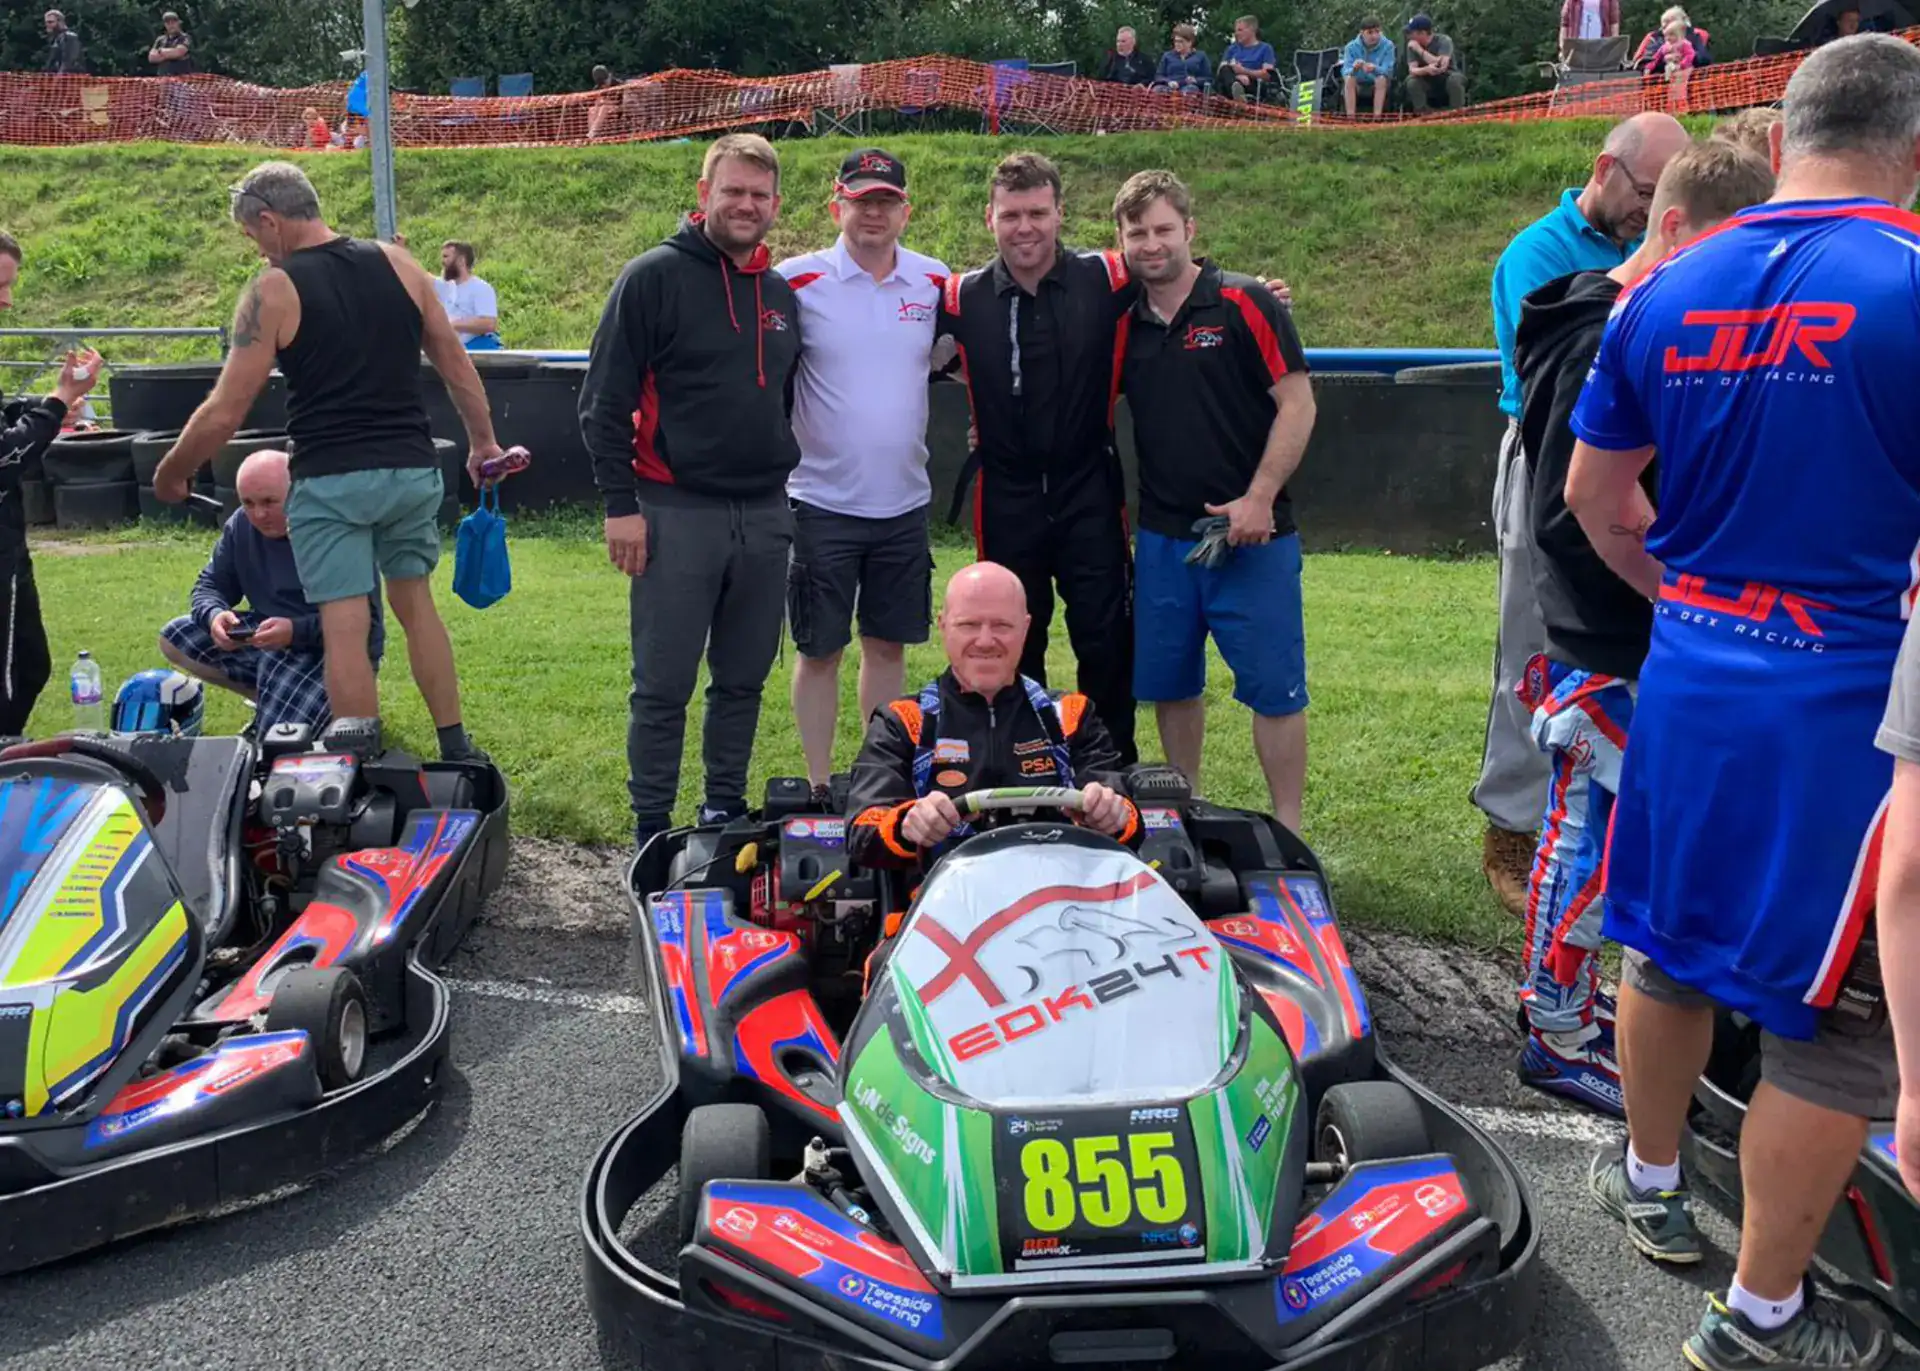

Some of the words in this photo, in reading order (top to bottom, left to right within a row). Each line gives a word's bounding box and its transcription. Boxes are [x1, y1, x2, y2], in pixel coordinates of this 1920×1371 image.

[1663, 302, 1857, 373] JDR
[1680, 611, 1719, 627] DEX
[1734, 624, 1825, 653] RACING
[948, 946, 1213, 1063] EDK24T
[1021, 1132, 1187, 1232] 855
[1298, 1253, 1355, 1294] Teesside
[862, 1295, 922, 1328] karting
[866, 1282, 933, 1312] Teesside
